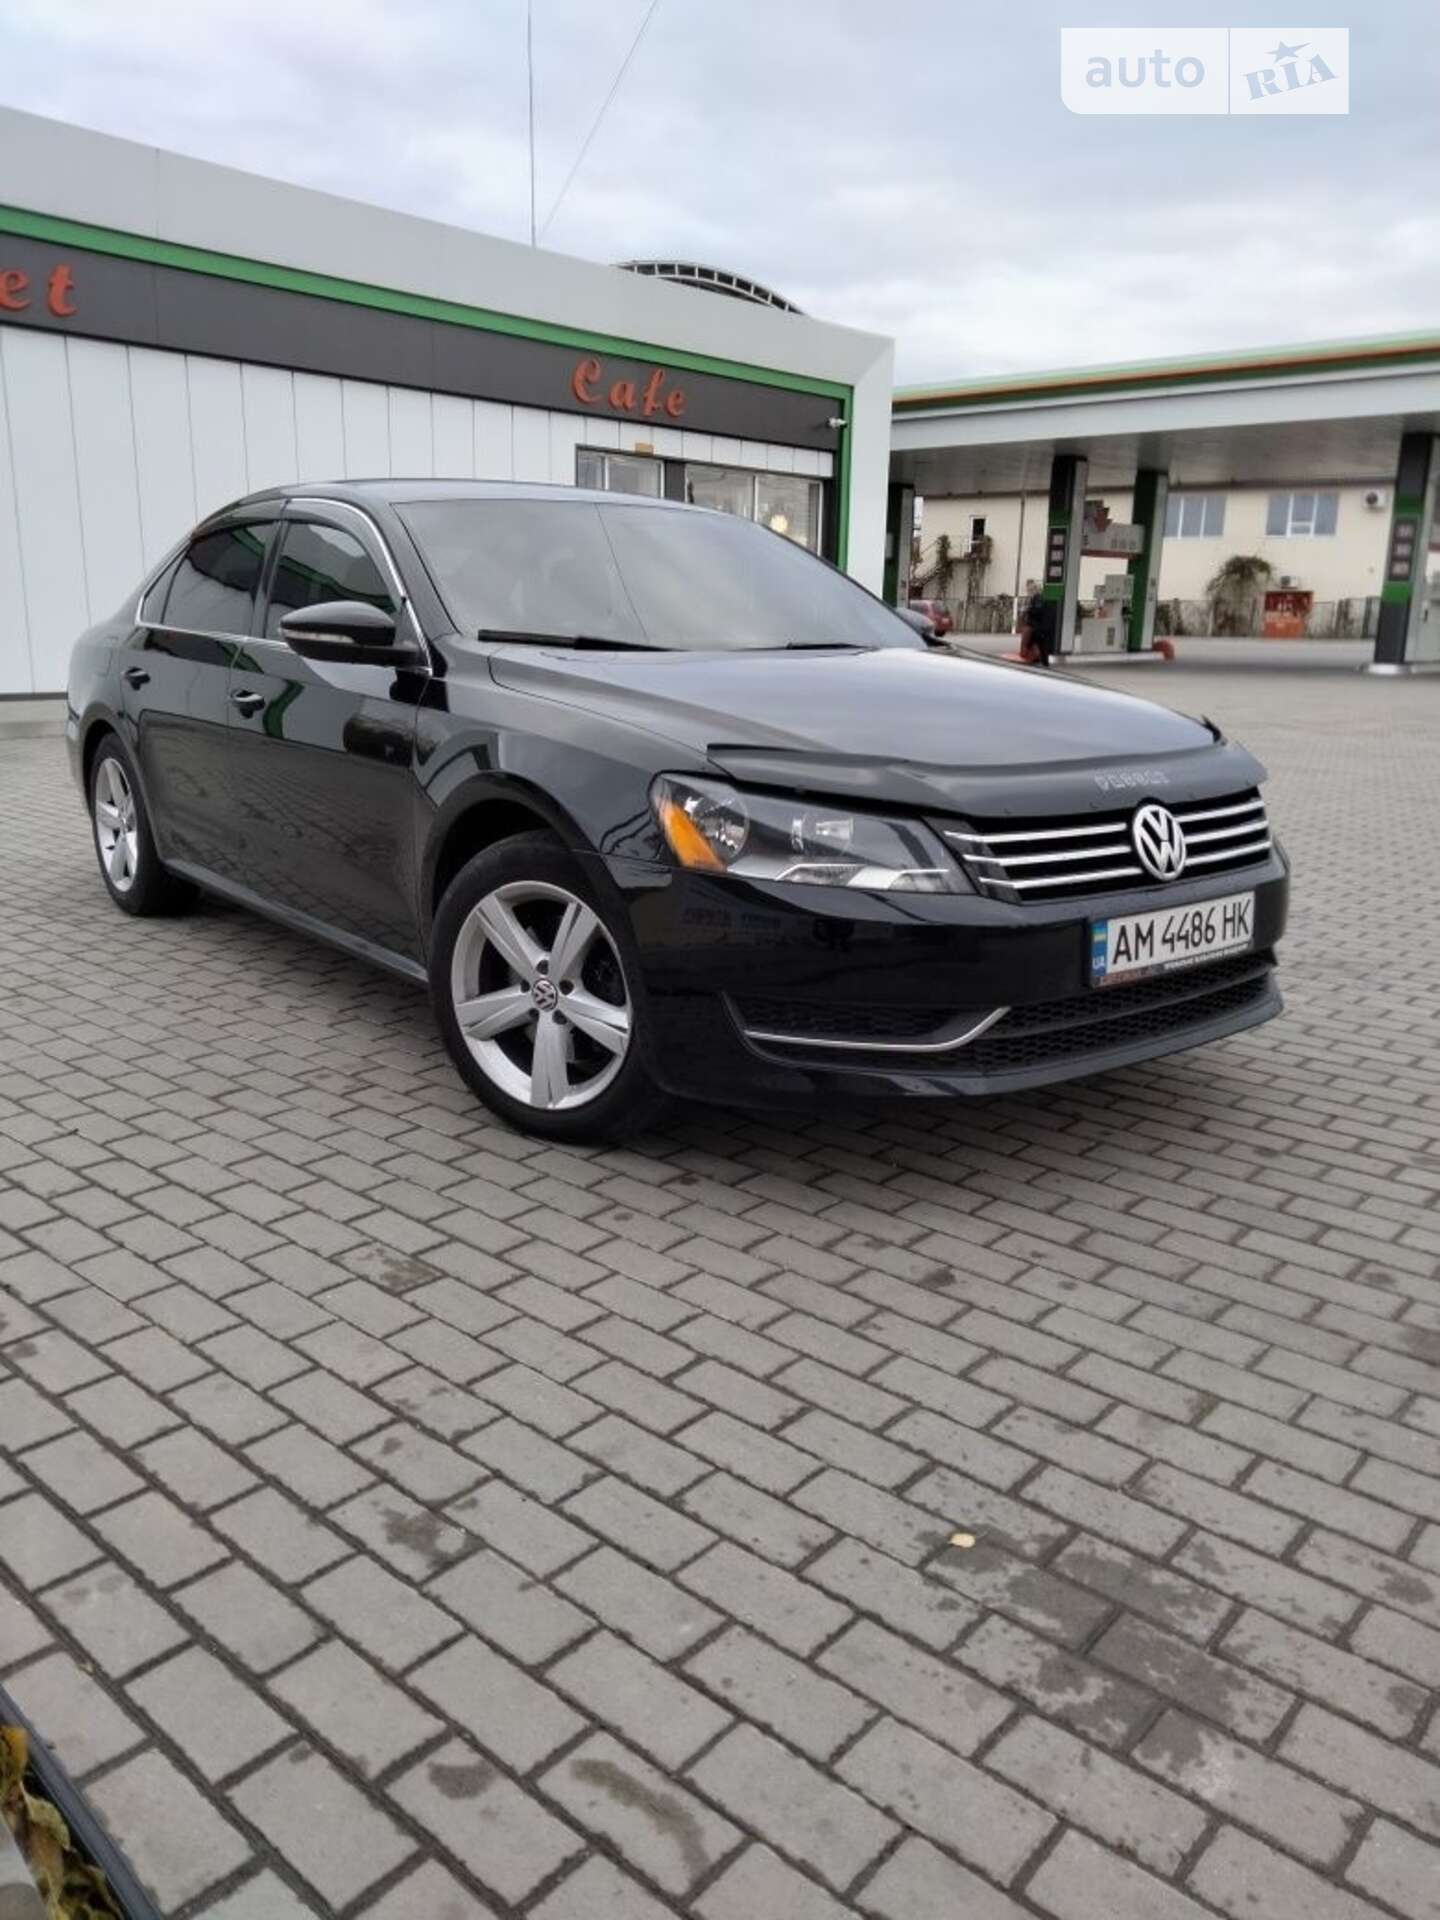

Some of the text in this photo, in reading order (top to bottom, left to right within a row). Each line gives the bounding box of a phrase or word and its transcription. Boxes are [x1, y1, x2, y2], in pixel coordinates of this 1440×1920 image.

[571, 357, 687, 417] Cafe
[1112, 919, 1155, 965] AM
[1162, 907, 1216, 953] 4486
[1222, 898, 1252, 941] HK
